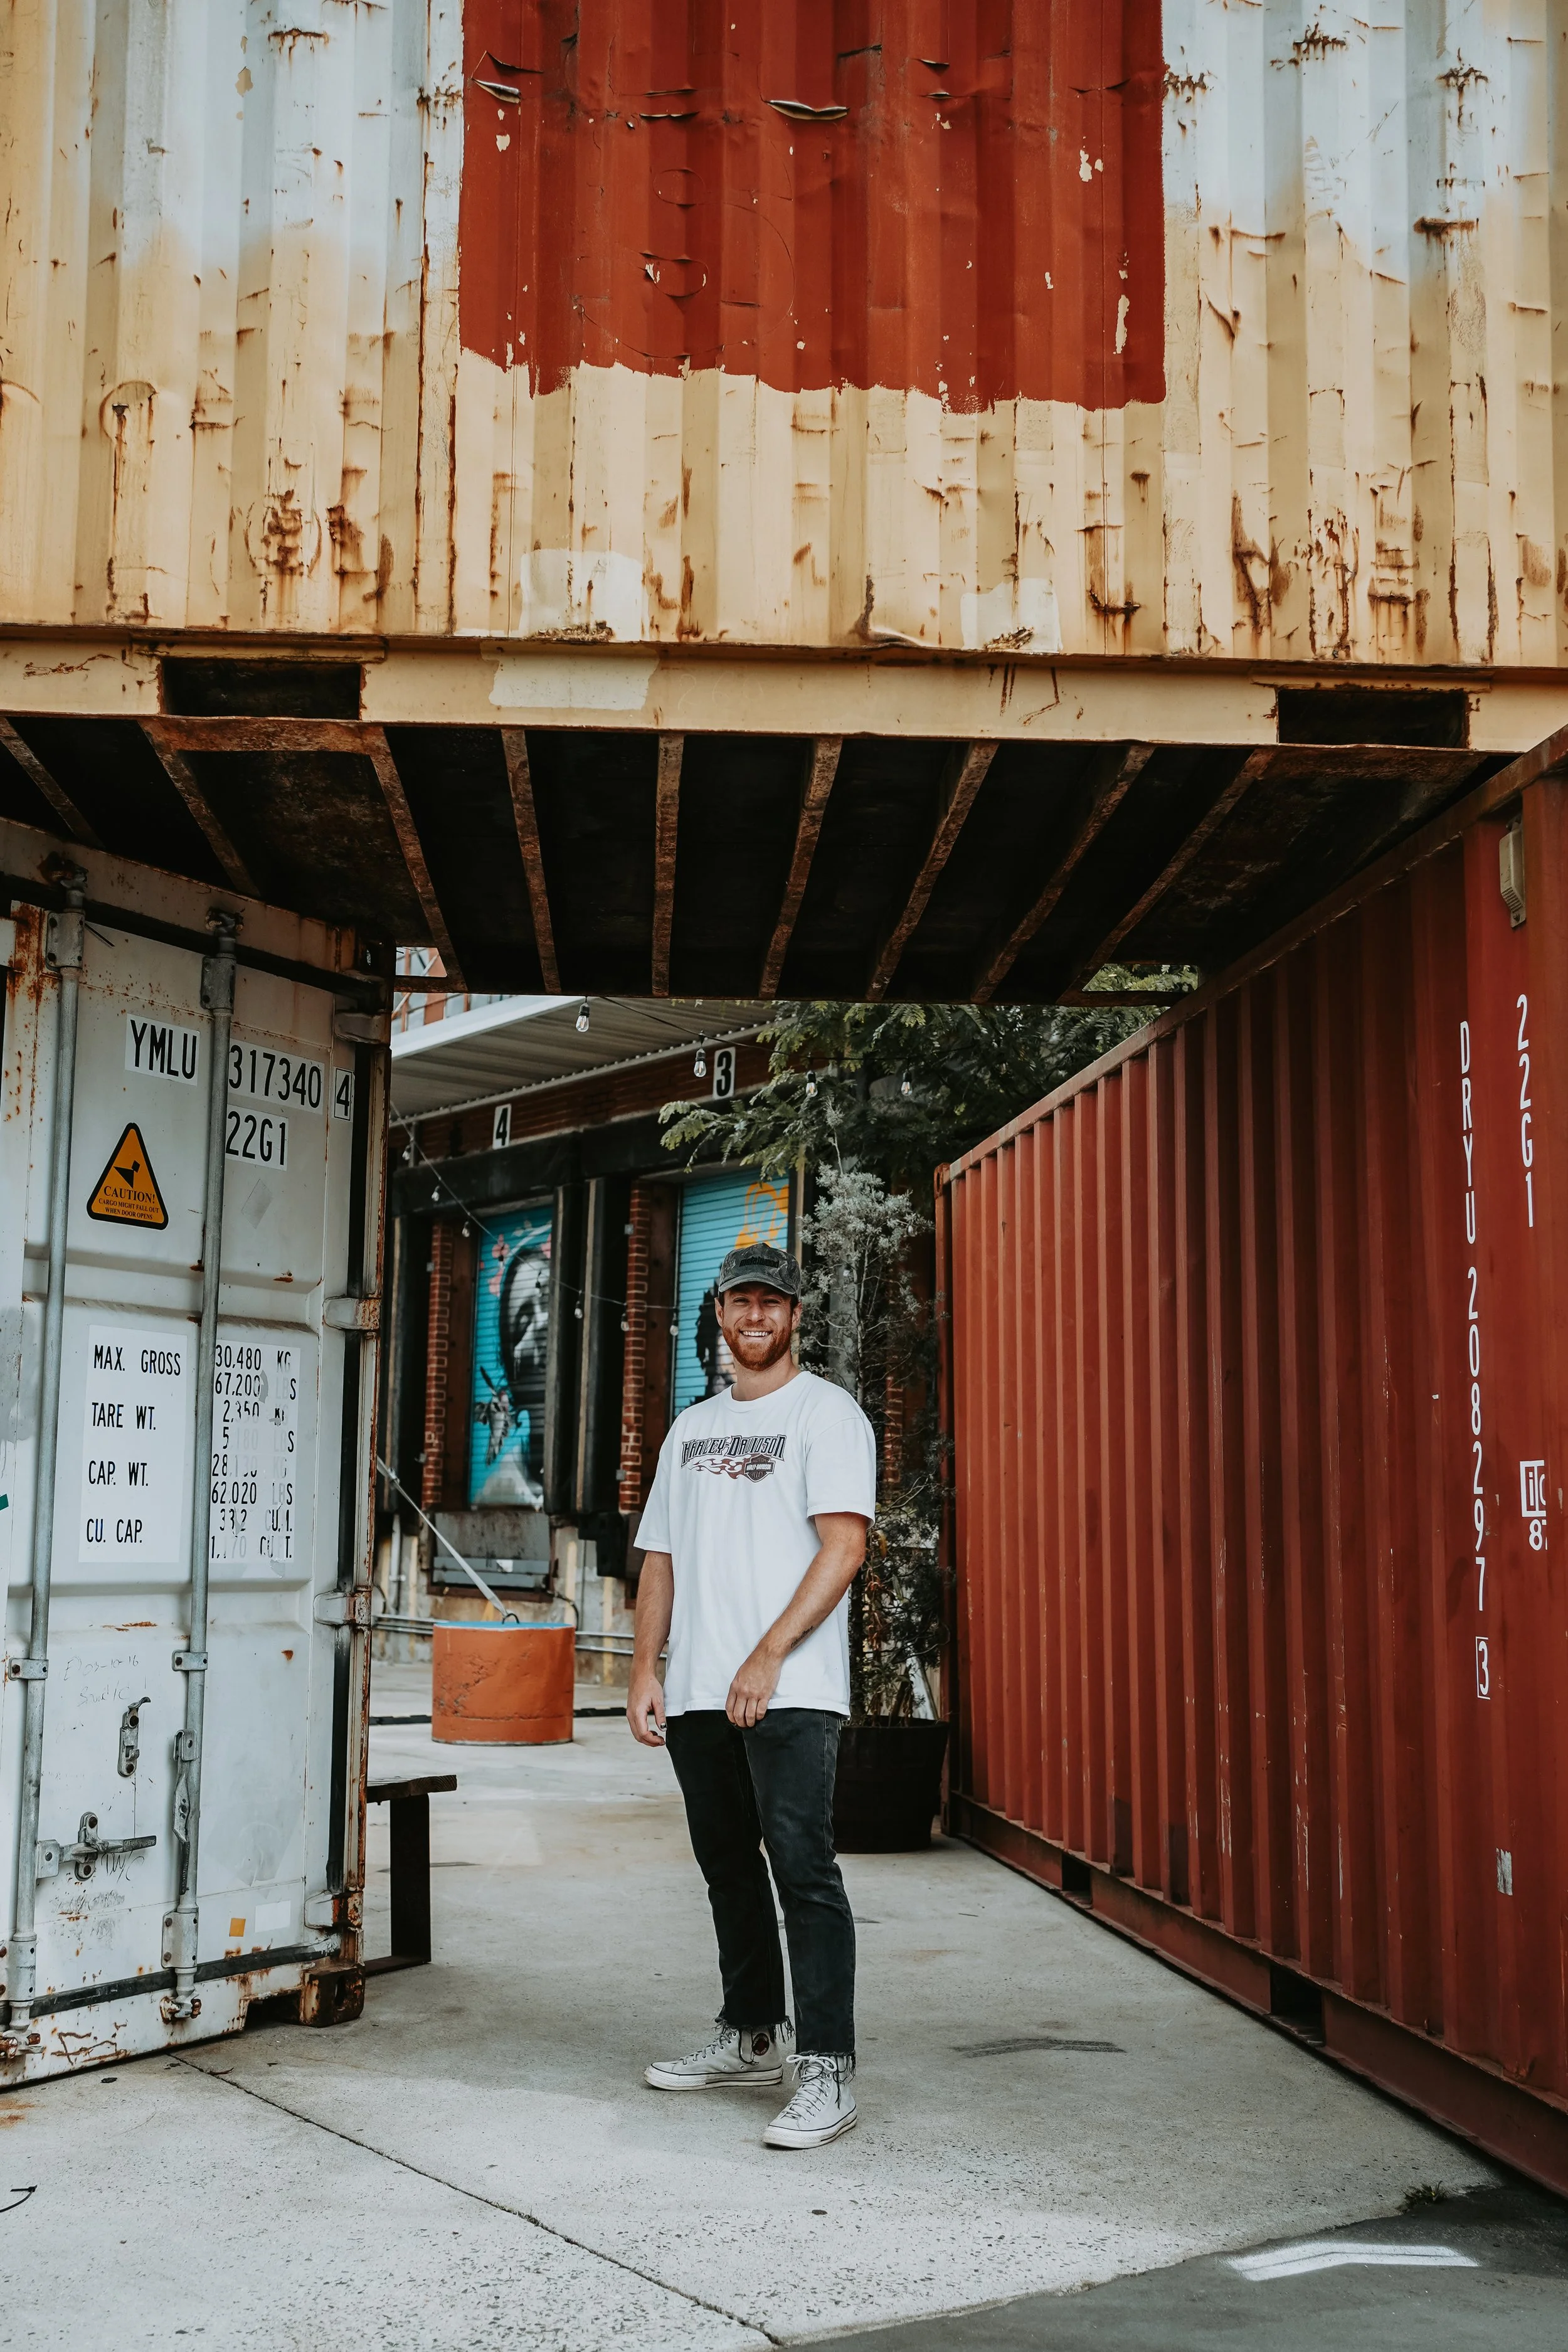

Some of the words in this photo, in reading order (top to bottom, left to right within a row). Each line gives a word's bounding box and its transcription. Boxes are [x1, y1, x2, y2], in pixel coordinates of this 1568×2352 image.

[130, 1020, 197, 1079] YMLU
[228, 1044, 322, 1108] 317340
[336, 1074, 350, 1116] 4
[716, 1051, 733, 1096] 3
[1517, 994, 1534, 1228] 22G1
[226, 1111, 285, 1166] 22G1
[495, 1108, 508, 1146] 4
[98, 1198, 117, 1206] CARGO
[118, 1201, 135, 1209] MIGHT
[103, 1185, 155, 1204] CAUTION!
[1460, 1020, 1476, 1244] DRYU
[1468, 1266, 1485, 1611] 208297
[93, 1344, 125, 1371] MAX.
[141, 1350, 181, 1376] GROSS
[215, 1344, 262, 1371] 30,480
[215, 1372, 261, 1397] 67,200
[92, 1402, 124, 1428] TARE
[136, 1406, 156, 1430] WT.
[88, 1460, 116, 1486] CAP.
[129, 1462, 149, 1486] WT.
[211, 1481, 257, 1504] 62,020
[86, 1518, 106, 1543] CU.
[116, 1518, 142, 1544] CAP.
